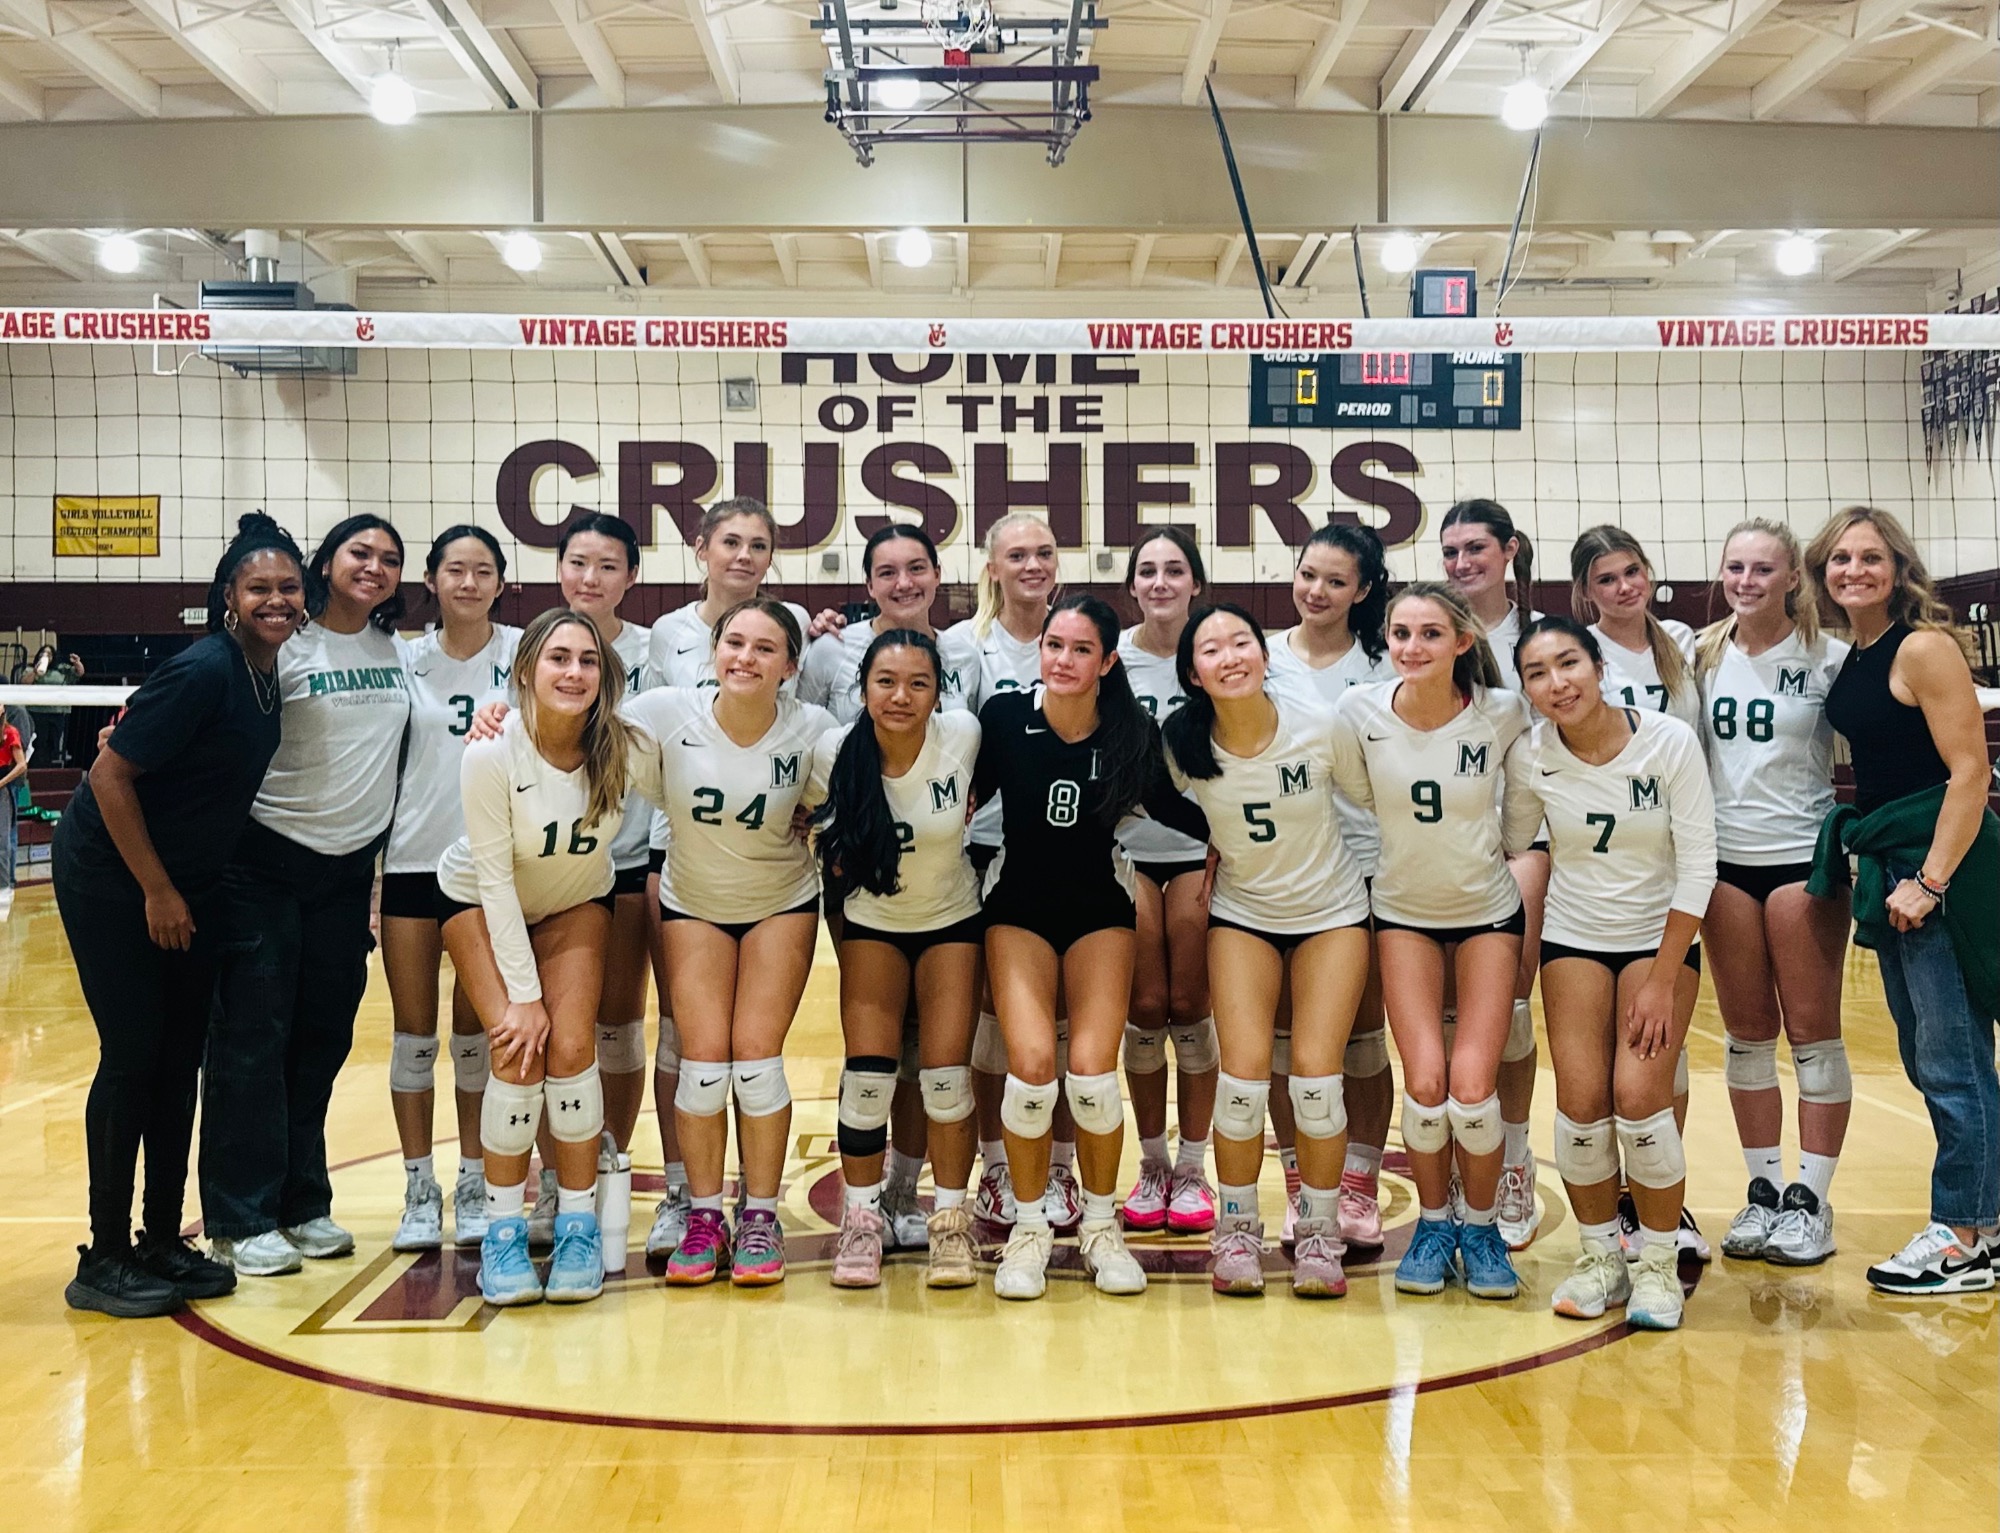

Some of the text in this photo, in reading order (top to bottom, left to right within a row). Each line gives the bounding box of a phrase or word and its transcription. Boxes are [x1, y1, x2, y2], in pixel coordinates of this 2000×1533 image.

[1445, 278, 1467, 315] 0
[0, 313, 210, 340] AGE CRUSHERS
[519, 319, 788, 348] VINTAGE CRUSHERS
[1087, 323, 1353, 350] VINTAGE CRUSHERS
[1657, 319, 1929, 347] VINTAGE CRUSHERS
[1452, 350, 1504, 364] HOME
[1297, 369, 1317, 405] 0
[1483, 371, 1503, 407] 0
[818, 395, 1103, 433] OF THE
[1337, 402, 1391, 416] PERIOD
[496, 441, 1423, 549] CRUSHERS
[60, 509, 153, 519] GIRLS VOLLEYBALL
[60, 526, 153, 537] SECTION CHAMPIONS
[308, 667, 408, 695] MIRAMONT
[940, 667, 963, 697] M
[1774, 665, 1811, 698] M
[448, 694, 474, 736] 3
[1713, 696, 1774, 743] 88
[769, 751, 802, 789] M
[1454, 740, 1492, 777] M
[926, 770, 961, 814] M
[1276, 760, 1313, 797] M
[1626, 775, 1662, 811] M
[691, 786, 767, 830] 24
[1046, 779, 1080, 827] 8
[1411, 780, 1443, 823] 9
[538, 817, 598, 858] 16
[1242, 802, 1276, 843] 5
[1586, 813, 1616, 854] 7
